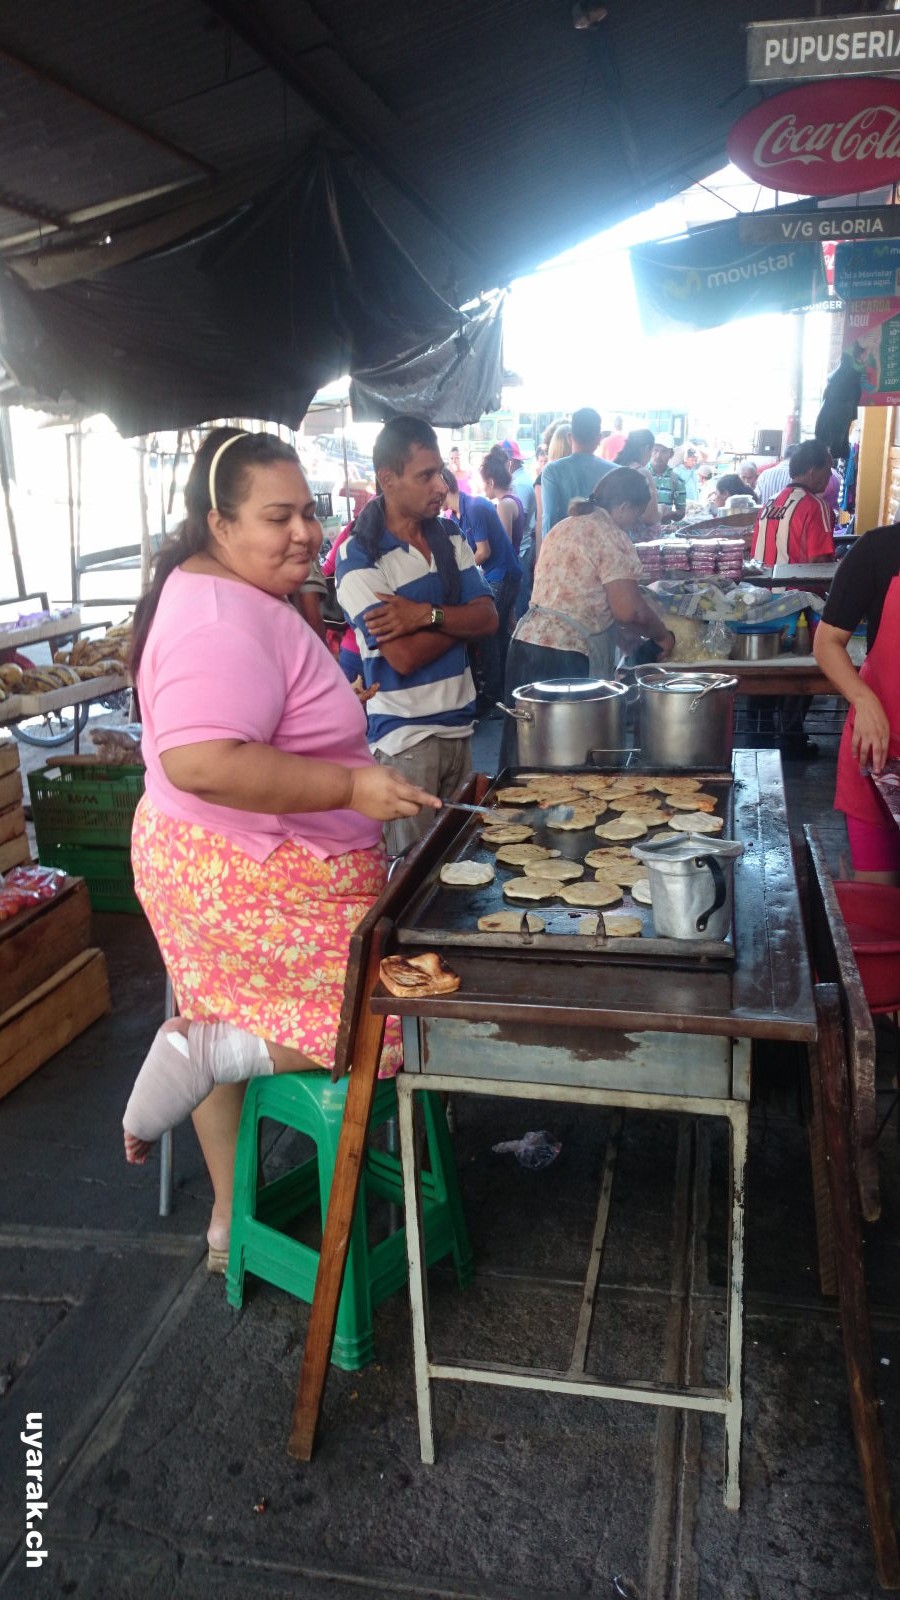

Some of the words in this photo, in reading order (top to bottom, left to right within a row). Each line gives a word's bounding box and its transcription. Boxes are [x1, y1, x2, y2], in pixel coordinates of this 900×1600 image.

[782, 219, 813, 240] V/G
[819, 217, 884, 236] GLORIA
[707, 252, 796, 289] movistar
[761, 499, 795, 520] Bud
